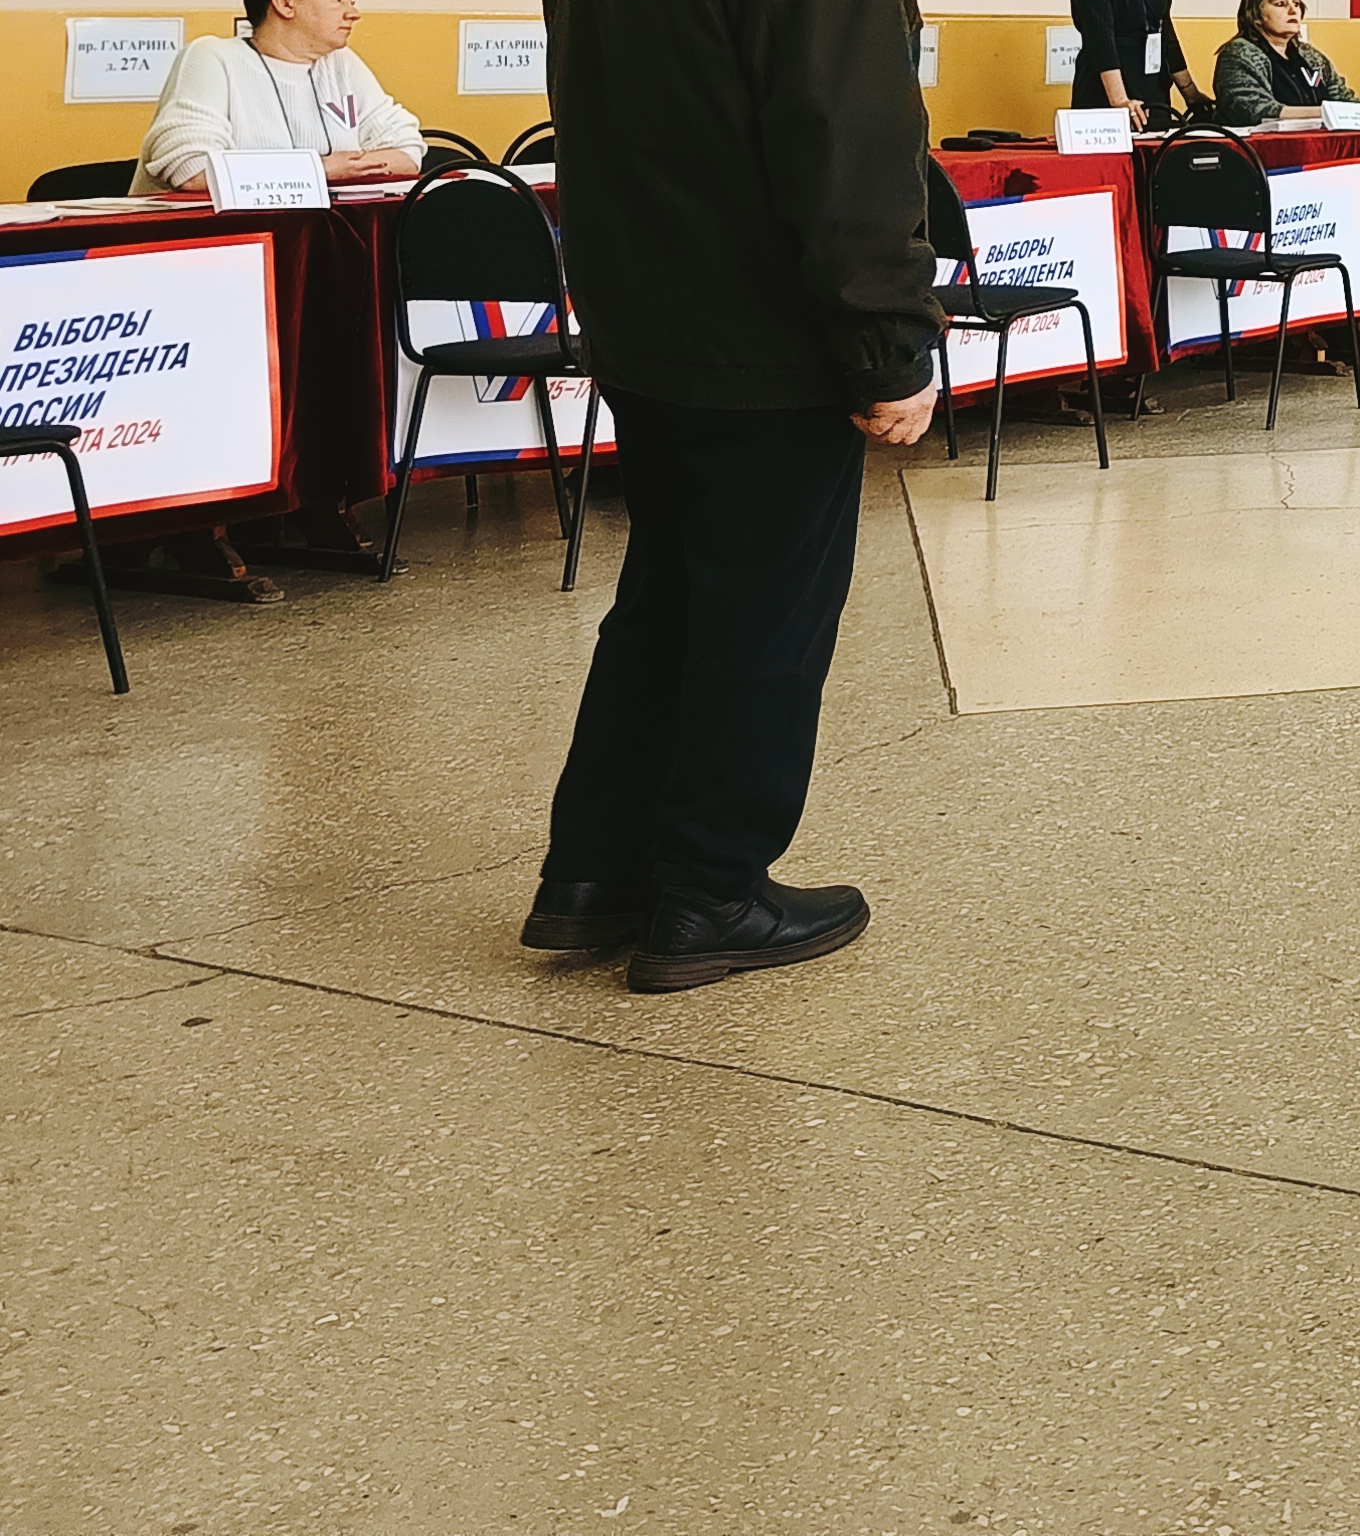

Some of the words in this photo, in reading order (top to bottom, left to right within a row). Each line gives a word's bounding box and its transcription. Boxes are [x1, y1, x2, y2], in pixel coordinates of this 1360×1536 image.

[101, 40, 176, 52] ГАГАРИНА
[486, 40, 544, 50] ГАГАРИНА
[121, 57, 150, 71] 27А
[516, 55, 530, 67] 33
[256, 181, 312, 190] ГАГАРИНА
[290, 193, 303, 204] 27
[1275, 202, 1323, 225] ВЫБОРЫ
[985, 237, 1055, 264] ВЫБОРЫ
[978, 260, 1074, 286] ПРЕЗИДЕНТА
[13, 309, 153, 353] ВЫБОРЫ
[1031, 313, 1061, 333] 2024
[0, 342, 191, 392] ПРЕЗИДЕНТА
[0, 390, 107, 427] ОССИИ
[106, 419, 163, 449] 2024
